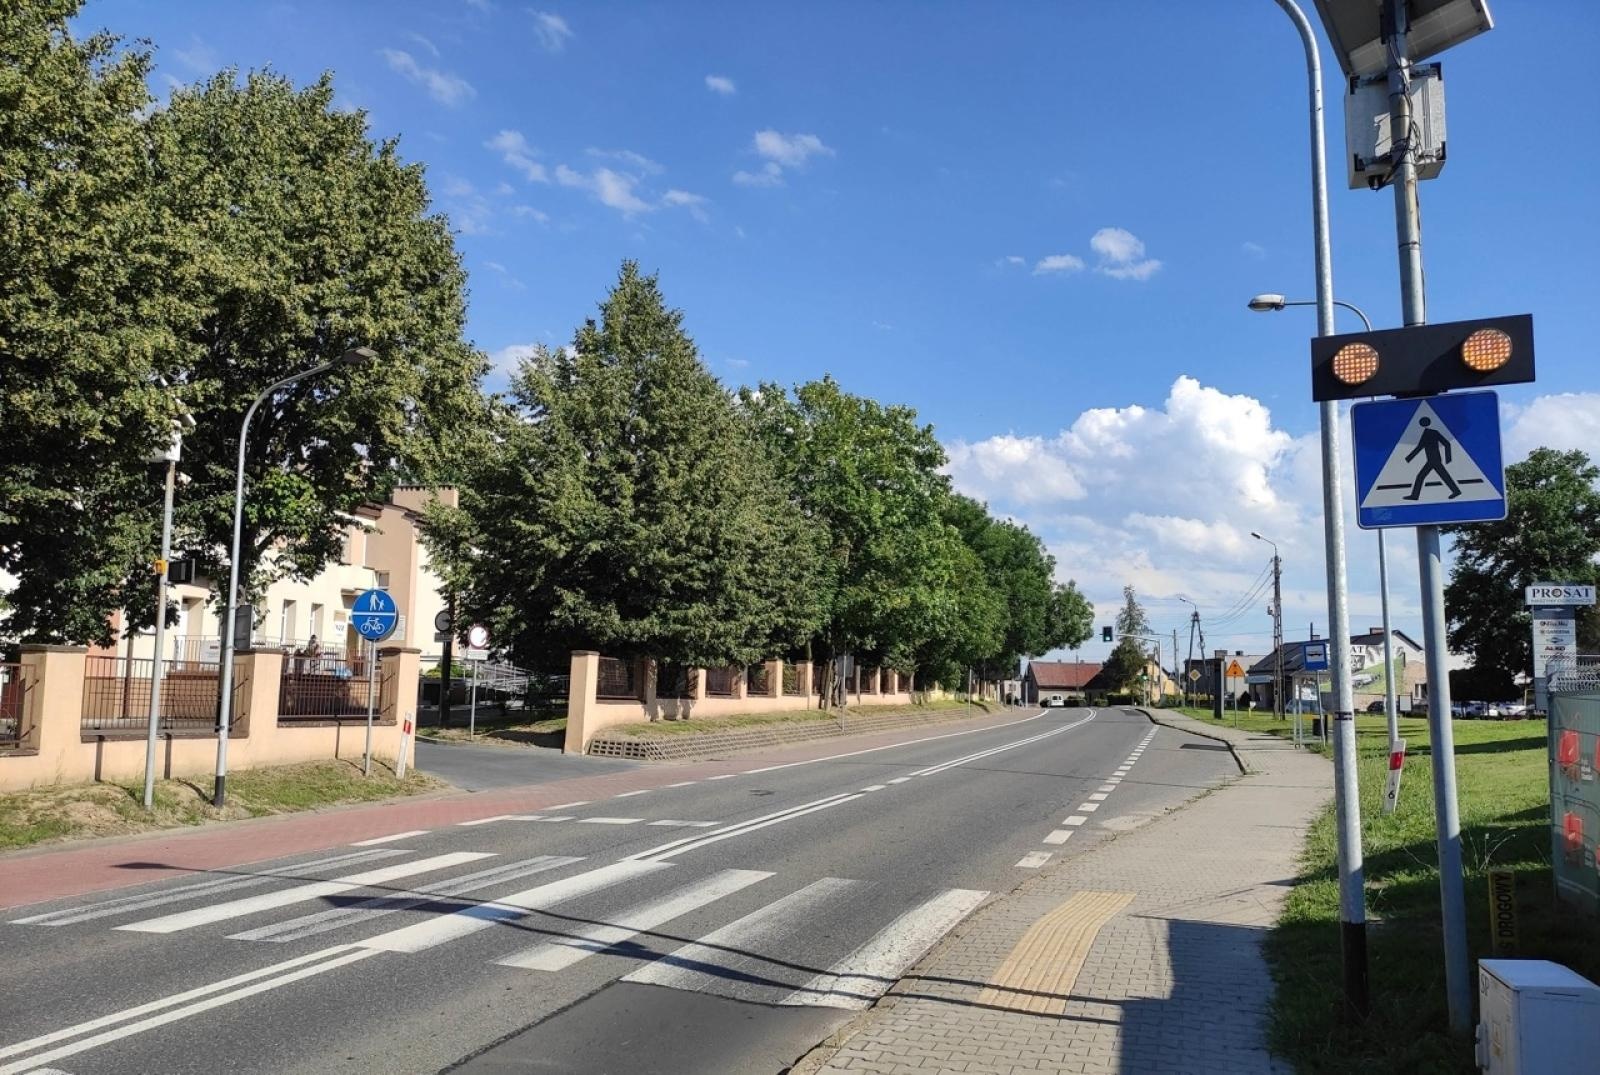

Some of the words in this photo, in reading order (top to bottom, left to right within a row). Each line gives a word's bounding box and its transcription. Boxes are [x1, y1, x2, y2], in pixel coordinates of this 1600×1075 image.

[1531, 588, 1592, 598] PROSAT
[1388, 790, 1395, 799] 6
[1494, 872, 1514, 938] DROGOWY
